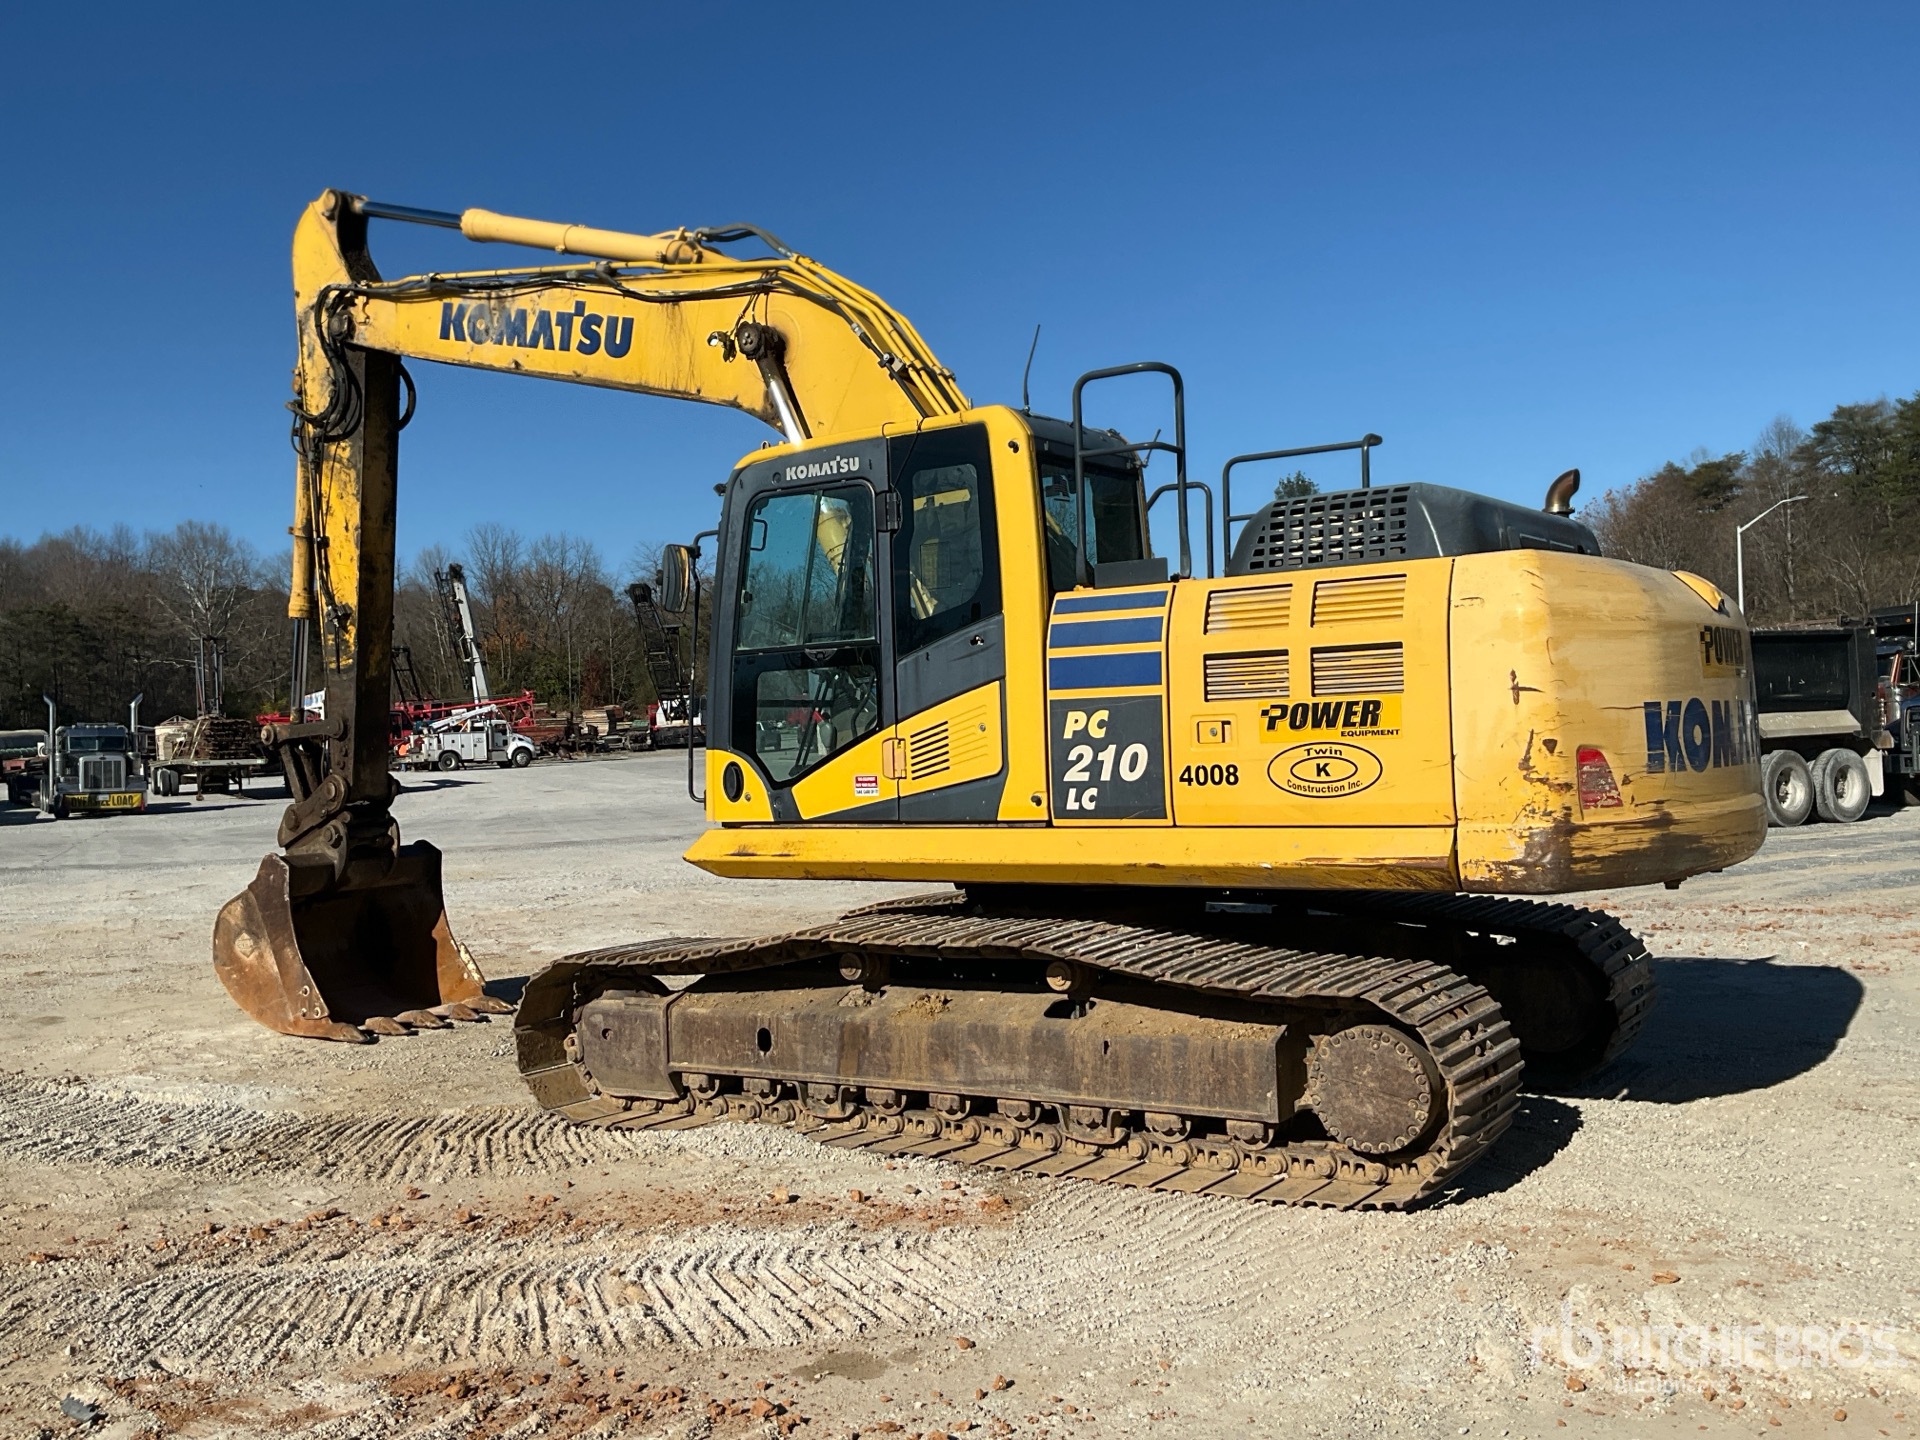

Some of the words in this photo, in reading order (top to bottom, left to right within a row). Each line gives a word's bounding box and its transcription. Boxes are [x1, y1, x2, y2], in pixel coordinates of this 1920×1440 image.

[439, 300, 634, 358] KOMATSU
[785, 455, 859, 480] KOMATSU
[1063, 710, 1110, 739] PC
[1261, 700, 1382, 731] POWER
[1340, 729, 1400, 737] EQUIPMENT
[1644, 697, 1759, 774] KOM
[1063, 743, 1149, 782] 210
[1304, 746, 1343, 756] Twin
[1179, 764, 1239, 786] 4008
[1316, 763, 1331, 777] K
[1287, 779, 1345, 793] Construction
[1348, 780, 1363, 790] Inc.
[1066, 788, 1098, 810] LC
